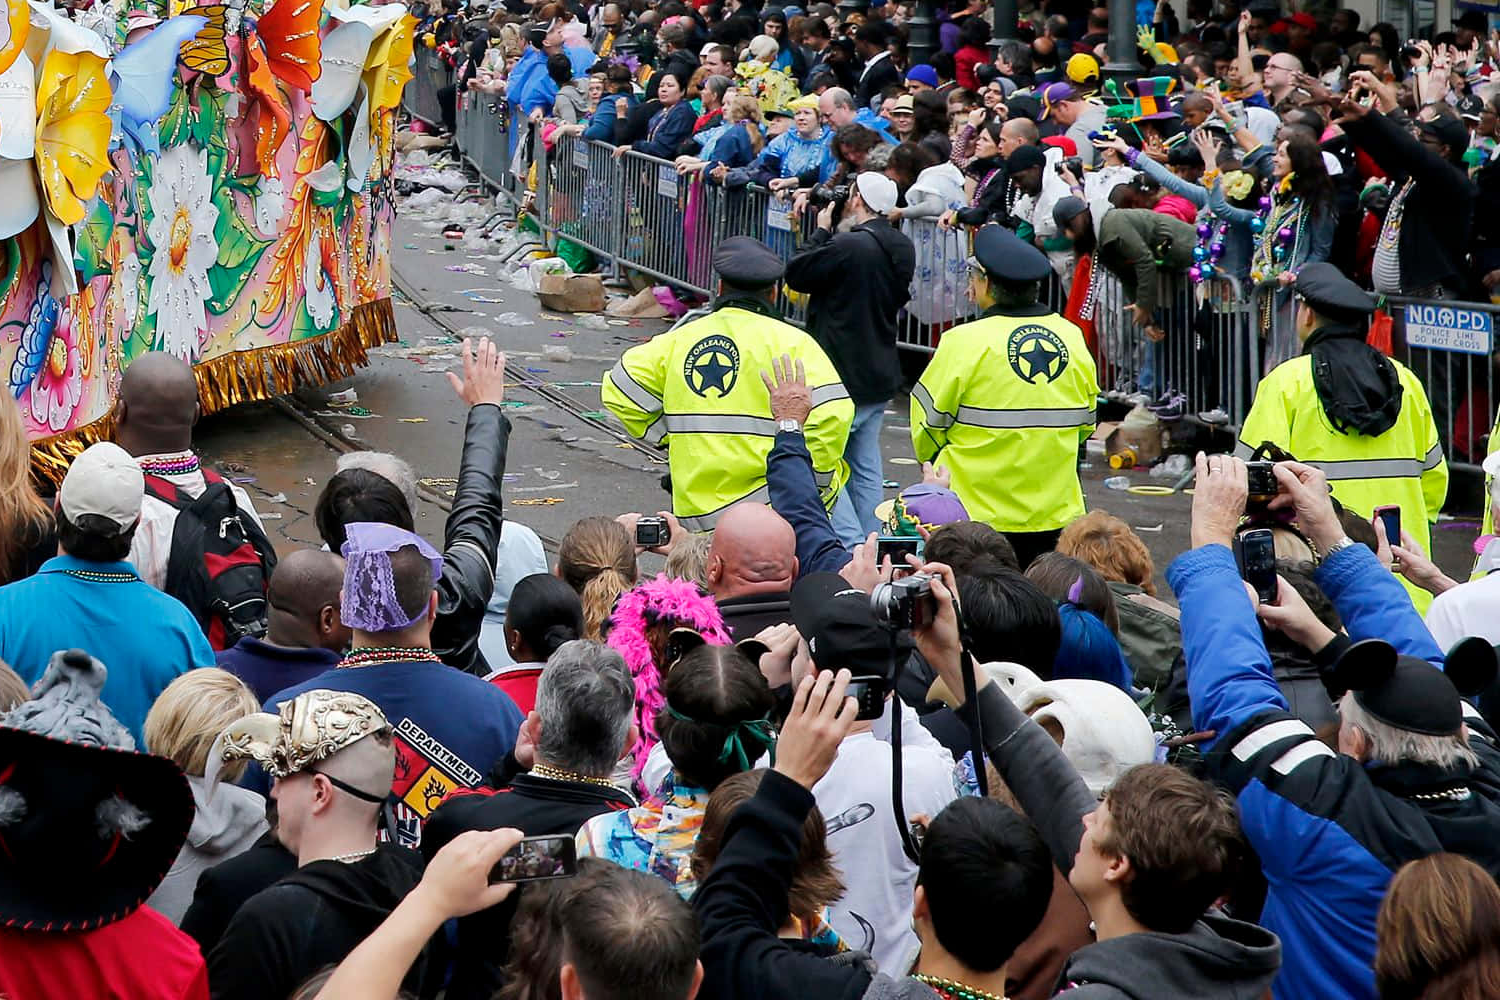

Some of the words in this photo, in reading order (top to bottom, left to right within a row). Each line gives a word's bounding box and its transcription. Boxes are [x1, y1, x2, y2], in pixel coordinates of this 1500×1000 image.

[1012, 327, 1049, 343] ORLEANS
[1414, 335, 1427, 344] DO
[1431, 337, 1449, 345] NOT
[1453, 339, 1481, 350] CROSS
[1420, 327, 1450, 338] POLICE
[1456, 330, 1474, 341] LINE
[684, 354, 696, 376] NEW
[693, 339, 732, 356] ORLEANS
[1008, 342, 1018, 364] NEW
[1048, 333, 1069, 362] POLICE
[399, 718, 483, 786] DEPARTMENT
